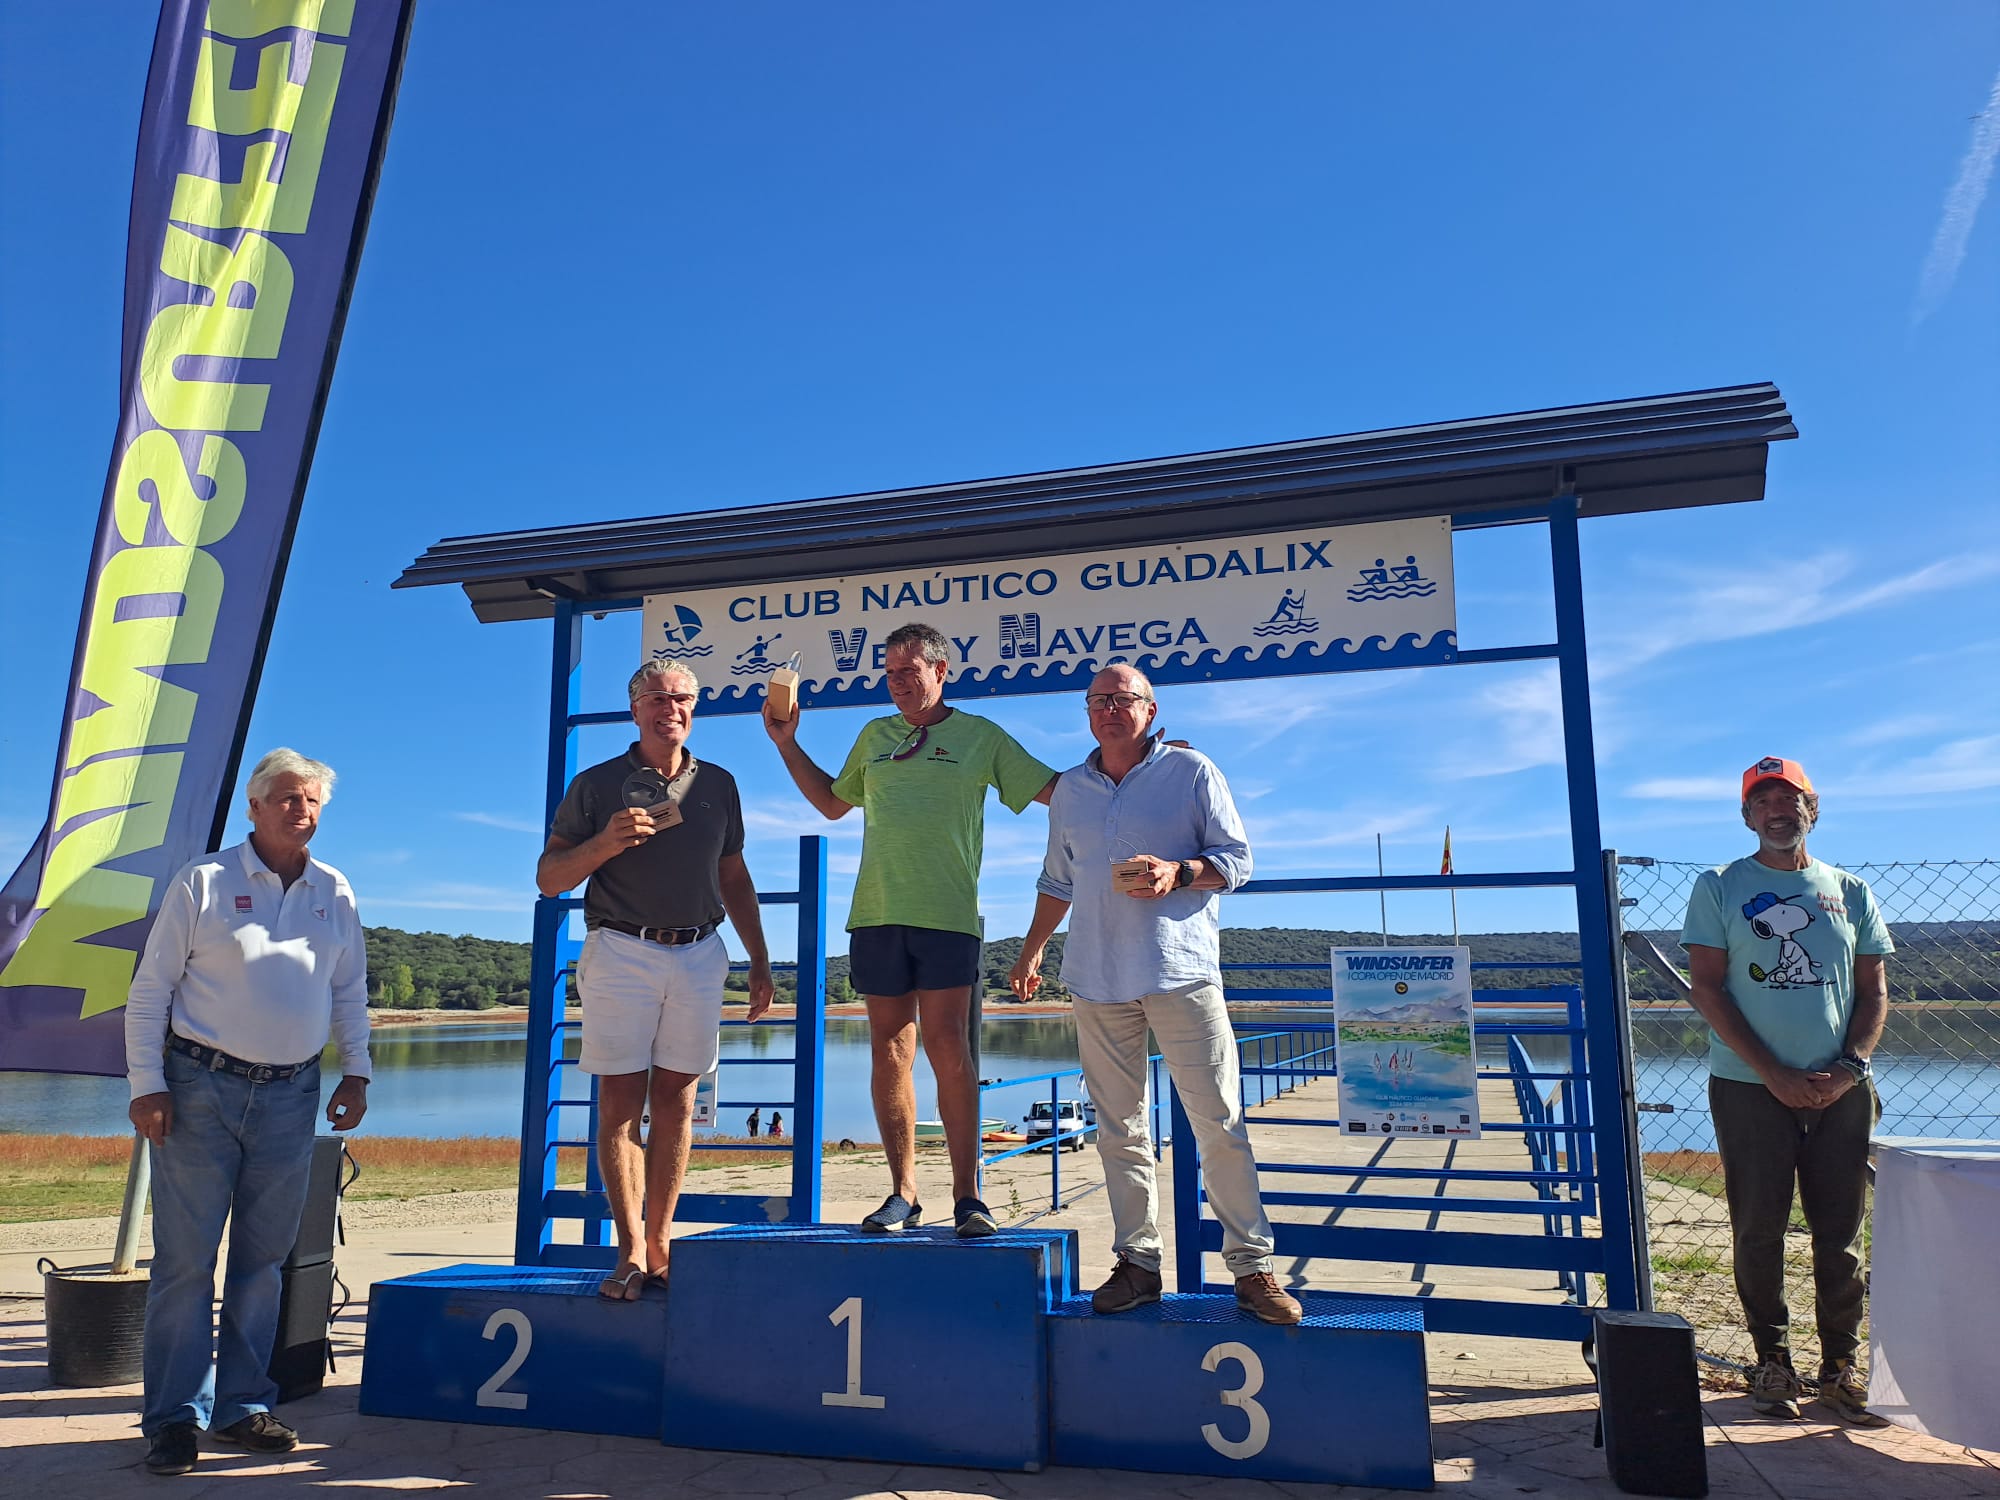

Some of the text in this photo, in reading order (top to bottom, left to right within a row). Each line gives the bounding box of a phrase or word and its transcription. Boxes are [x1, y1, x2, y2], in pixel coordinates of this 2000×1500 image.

[728, 539, 1334, 623] CLUB NAÚTICO GUADALIX
[828, 612, 1209, 672] VE Y NAVEGA
[1346, 956, 1454, 970] WINDSURFER
[1351, 972, 1376, 981] COPA
[1377, 972, 1403, 981] OPEN
[1404, 972, 1416, 981] DE
[1418, 972, 1454, 981] MADRID
[476, 1307, 533, 1410] 2
[821, 1296, 886, 1409] 1
[1200, 1340, 1271, 1460] 3
